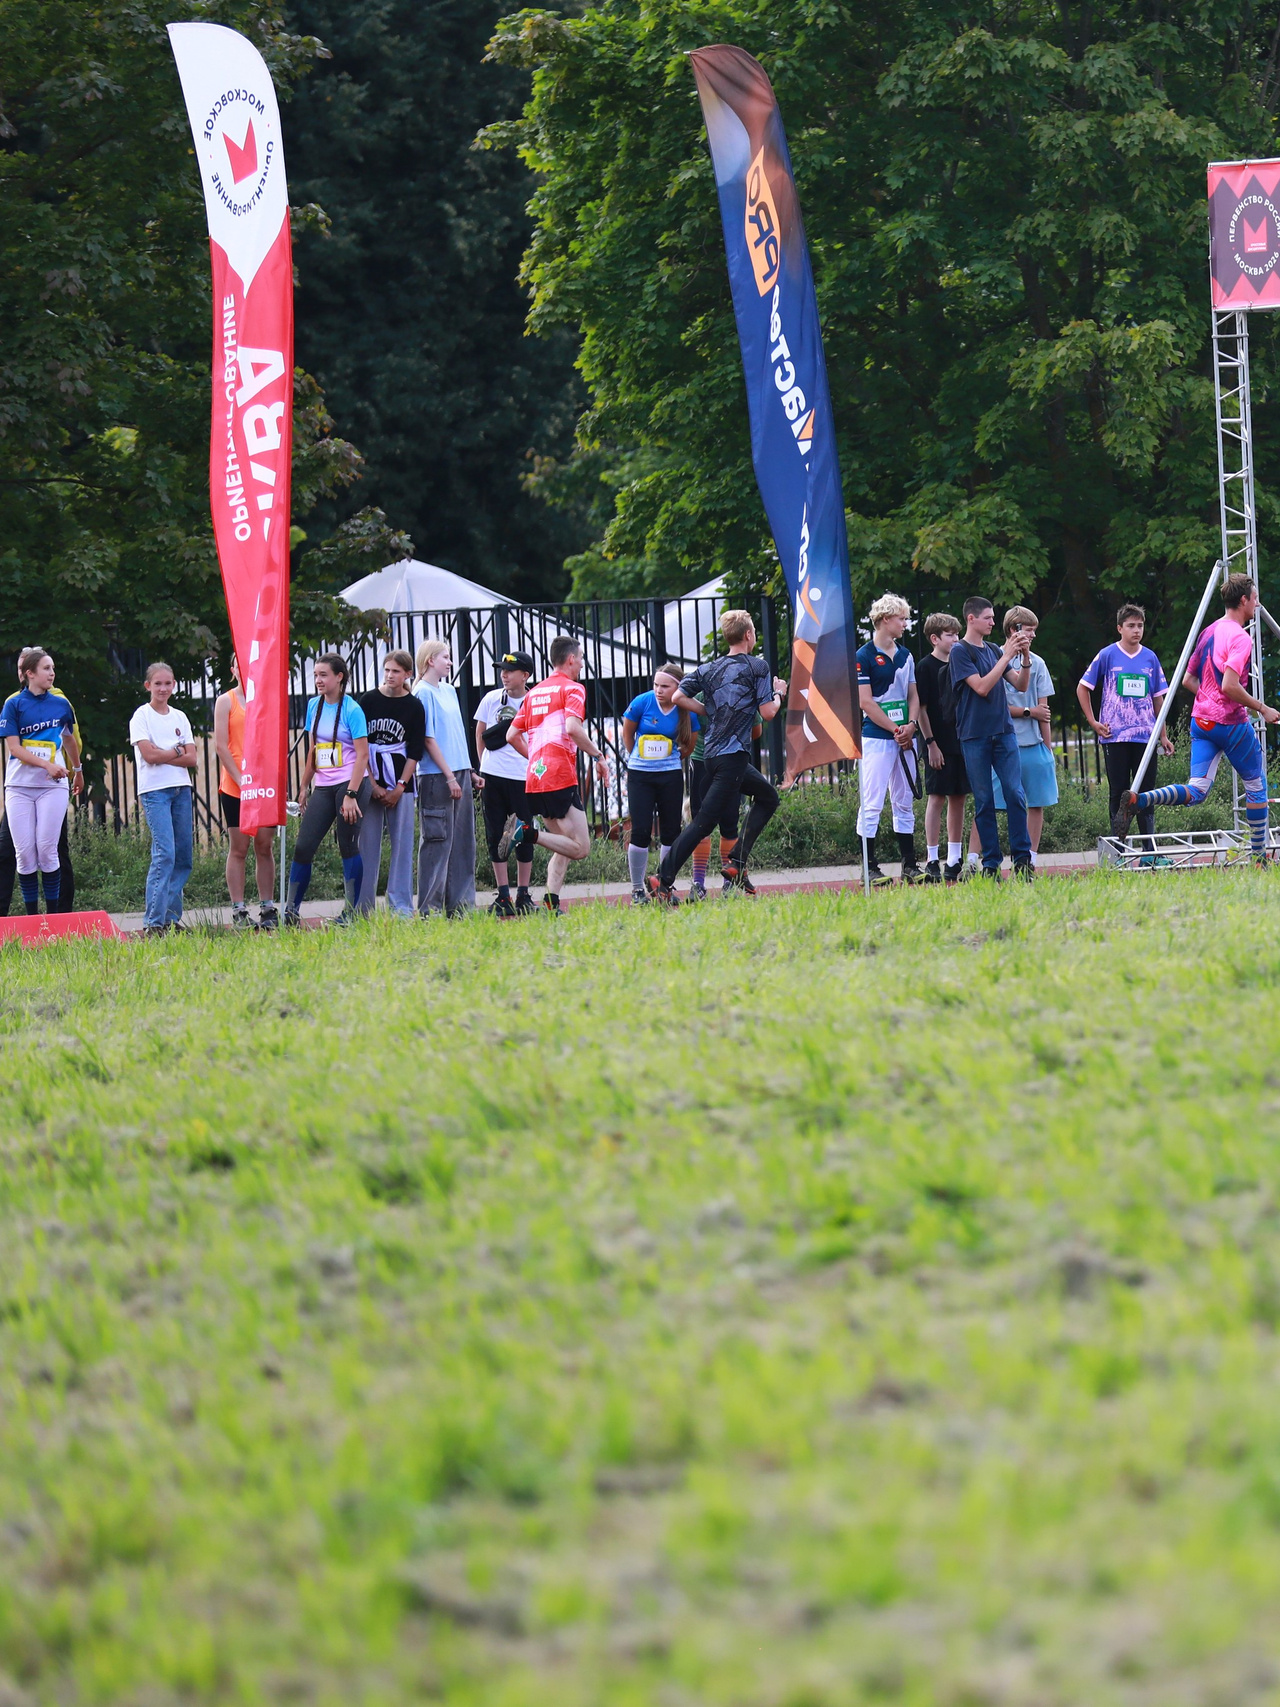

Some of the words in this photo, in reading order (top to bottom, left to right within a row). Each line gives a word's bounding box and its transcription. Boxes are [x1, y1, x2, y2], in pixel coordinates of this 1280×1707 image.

[1229, 195, 1263, 243] ПЕРВЕНСТВО
[1233, 253, 1264, 276] МОСКВА
[1264, 251, 1280, 272] 2026
[20, 720, 51, 735] СПОРТ
